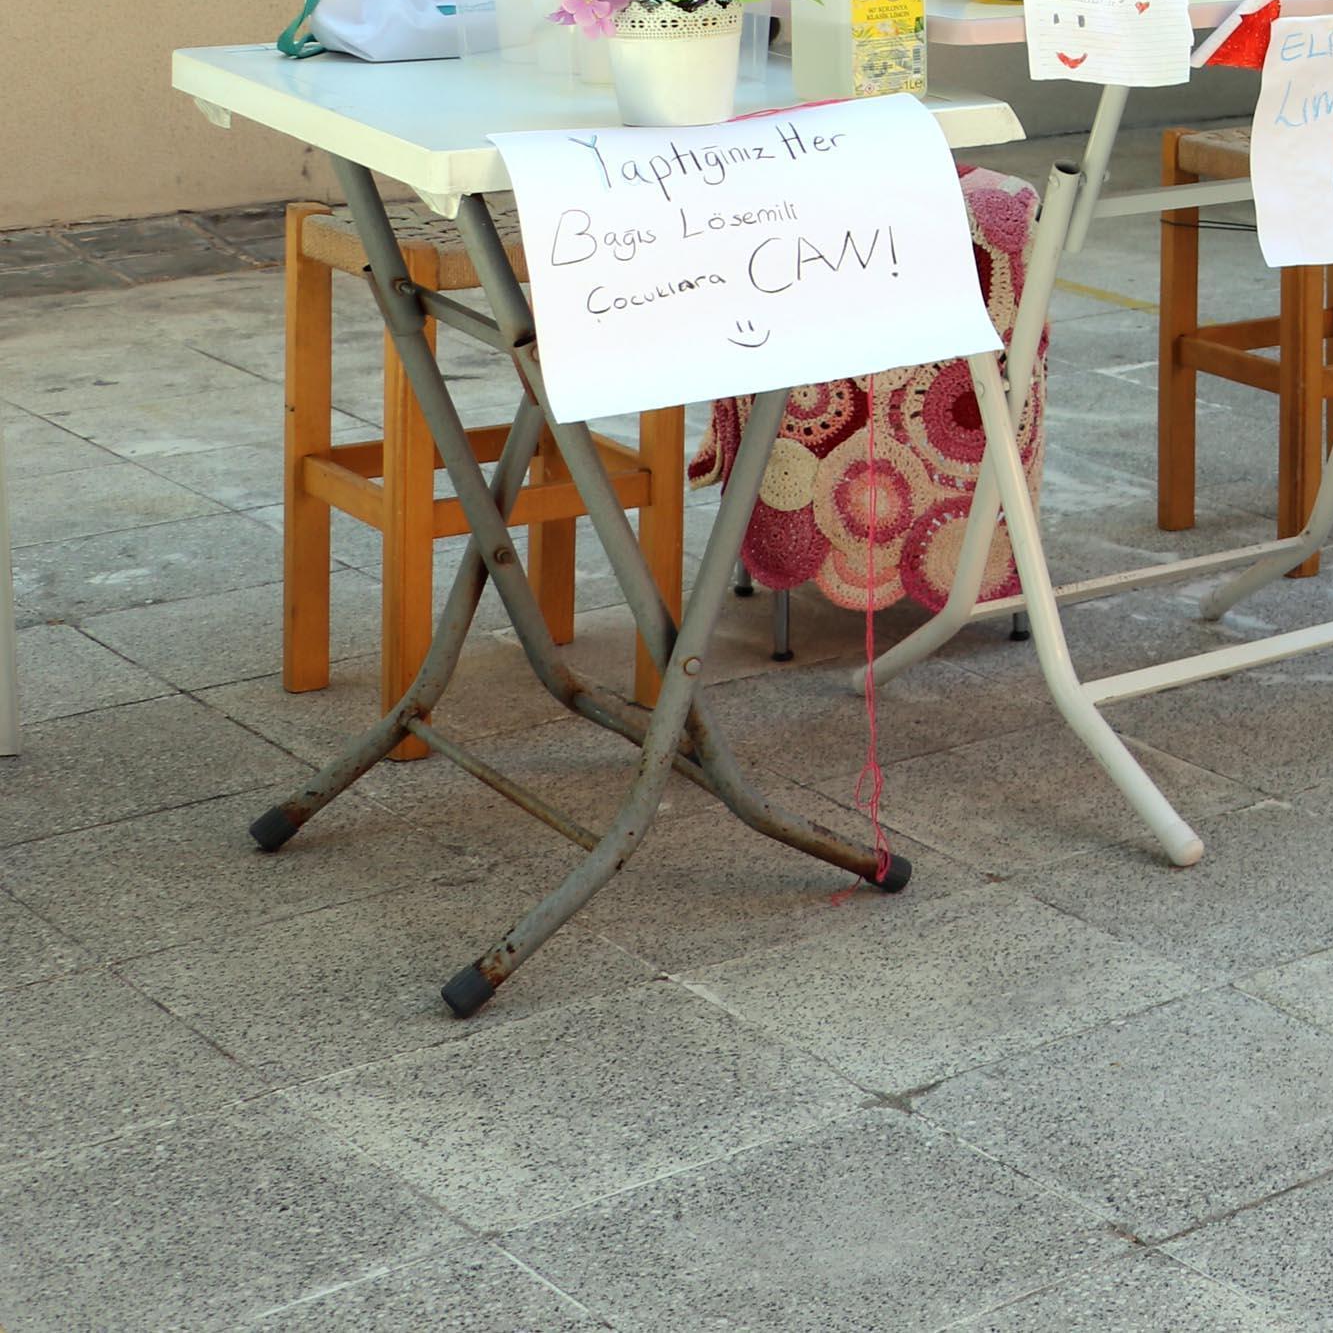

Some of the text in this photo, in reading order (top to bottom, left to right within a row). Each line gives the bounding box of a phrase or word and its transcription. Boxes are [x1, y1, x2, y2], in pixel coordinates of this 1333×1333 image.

[568, 122, 846, 201] Yaptığınız Her
[680, 200, 798, 239] Lösemili
[748, 226, 899, 294] CAN!
